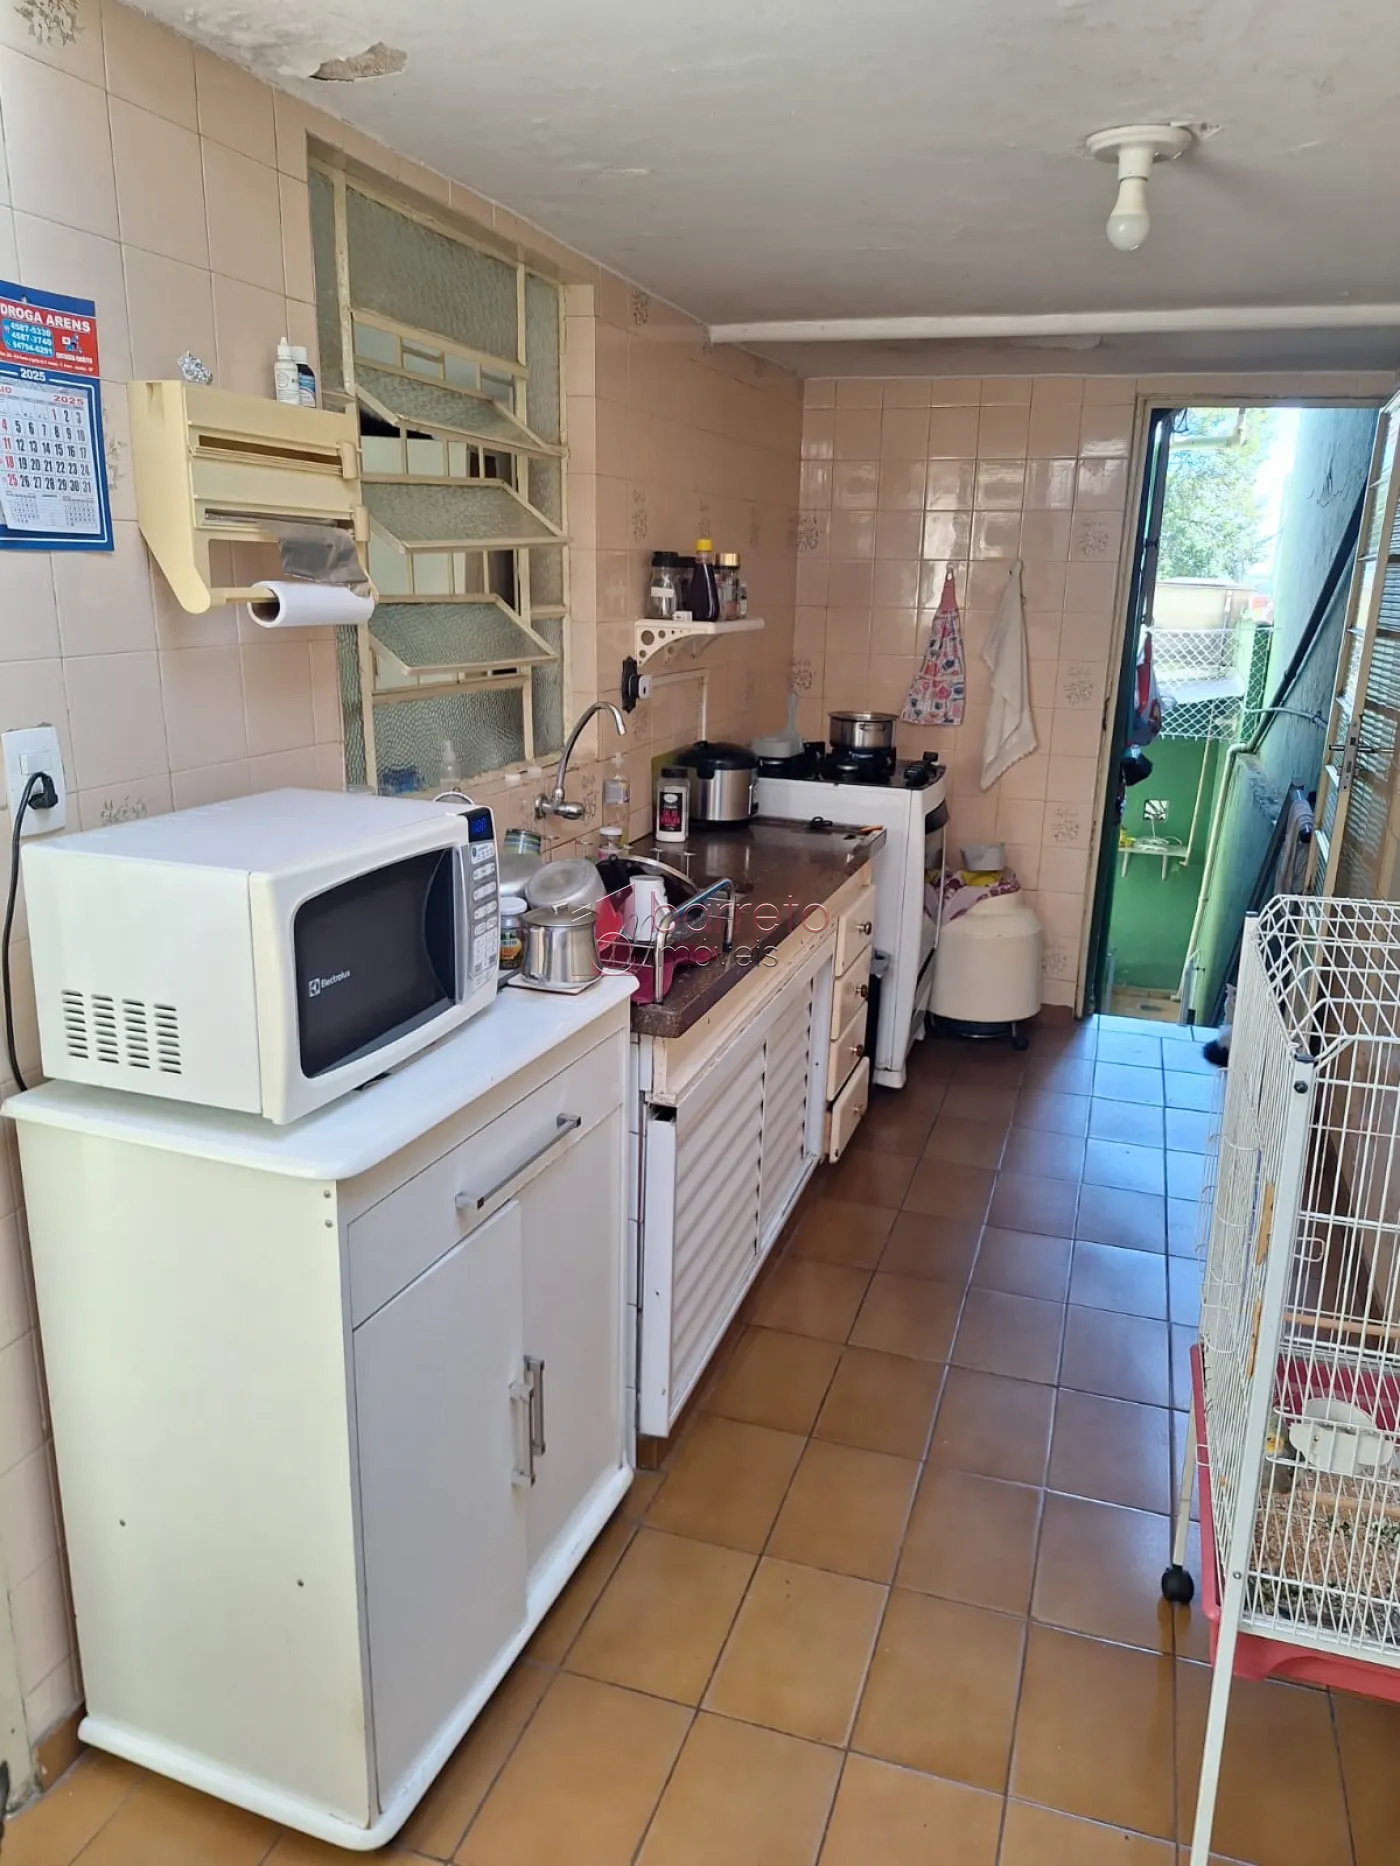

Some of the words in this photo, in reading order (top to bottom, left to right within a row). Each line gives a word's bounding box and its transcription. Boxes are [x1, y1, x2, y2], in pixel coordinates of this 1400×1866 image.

[0, 303, 43, 323] DROGA
[46, 315, 91, 333] ARENS
[20, 367, 46, 381] 2025
[54, 395, 84, 406] 2025
[52, 408, 57, 420] 1
[64, 410, 69, 422] 2
[2, 418, 8, 432] 4
[15, 420, 21, 434] 5
[29, 421, 35, 435] 6
[42, 424, 47, 436] 7
[54, 425, 60, 438] 8
[66, 427, 72, 440] 9
[77, 429, 86, 442] 10
[3, 437, 12, 450] 11
[16, 439, 25, 452] 12
[29, 440, 38, 454] 13
[42, 442, 51, 455] 14
[55, 443, 64, 457] 15
[67, 445, 76, 458] 16
[79, 447, 87, 460] 17
[6, 455, 15, 469] 18
[19, 457, 28, 470] 19
[31, 458, 41, 471] 20
[44, 459, 53, 473] 21
[56, 461, 66, 474] 22
[68, 462, 78, 476] 23
[8, 473, 18, 487] 25
[20, 474, 30, 488] 26
[34, 476, 42, 489] 27
[45, 477, 56, 490] 28
[57, 478, 68, 491] 29
[70, 479, 80, 492] 30
[83, 481, 92, 493] 31
[321, 970, 351, 988] Electrolux
